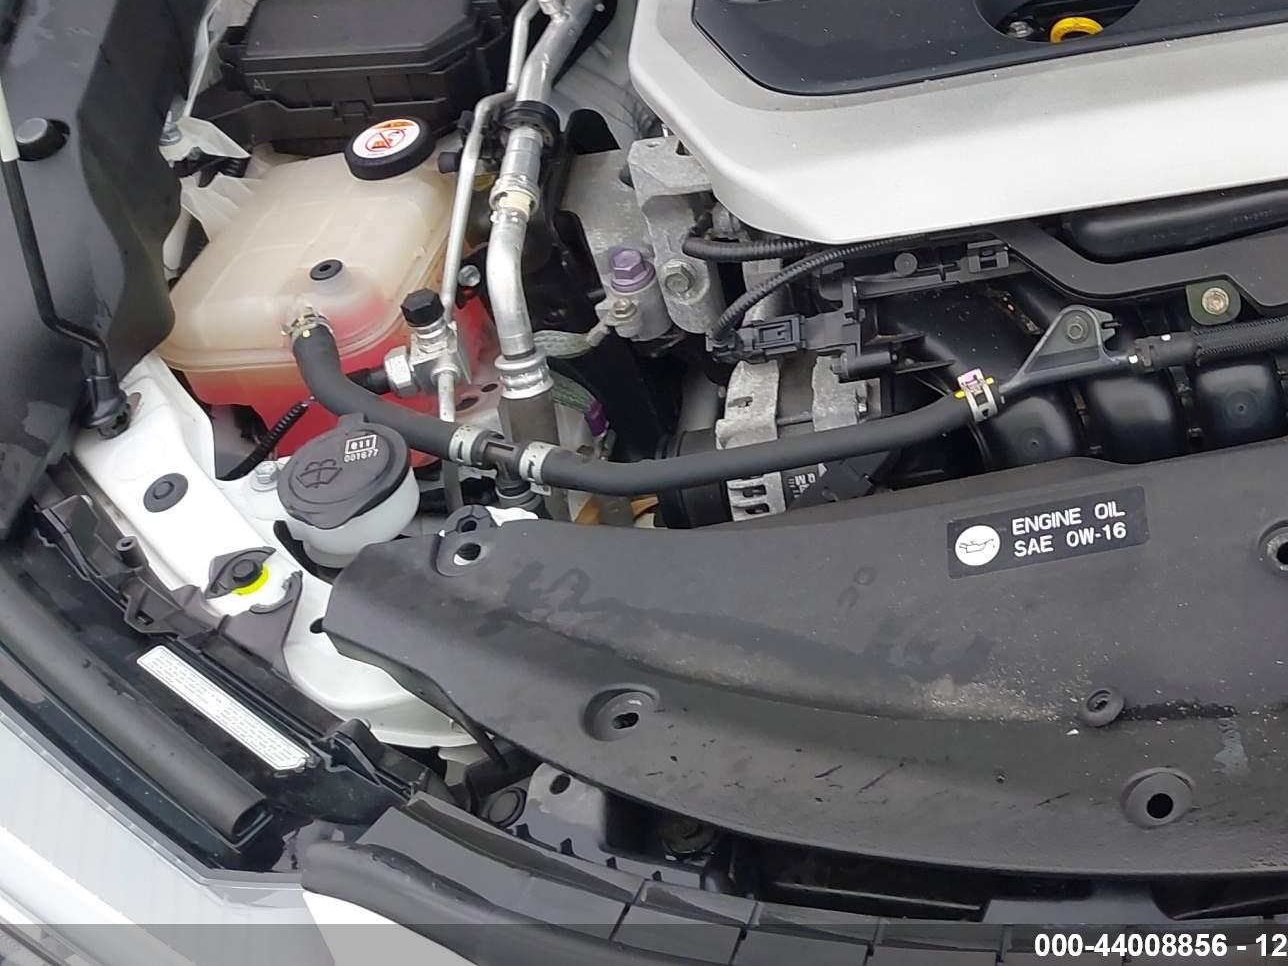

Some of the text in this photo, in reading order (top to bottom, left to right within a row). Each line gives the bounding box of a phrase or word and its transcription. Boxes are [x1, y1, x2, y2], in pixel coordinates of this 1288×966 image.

[1012, 501, 1126, 535] ENGINE OIL
[1014, 535, 1054, 558] SAE
